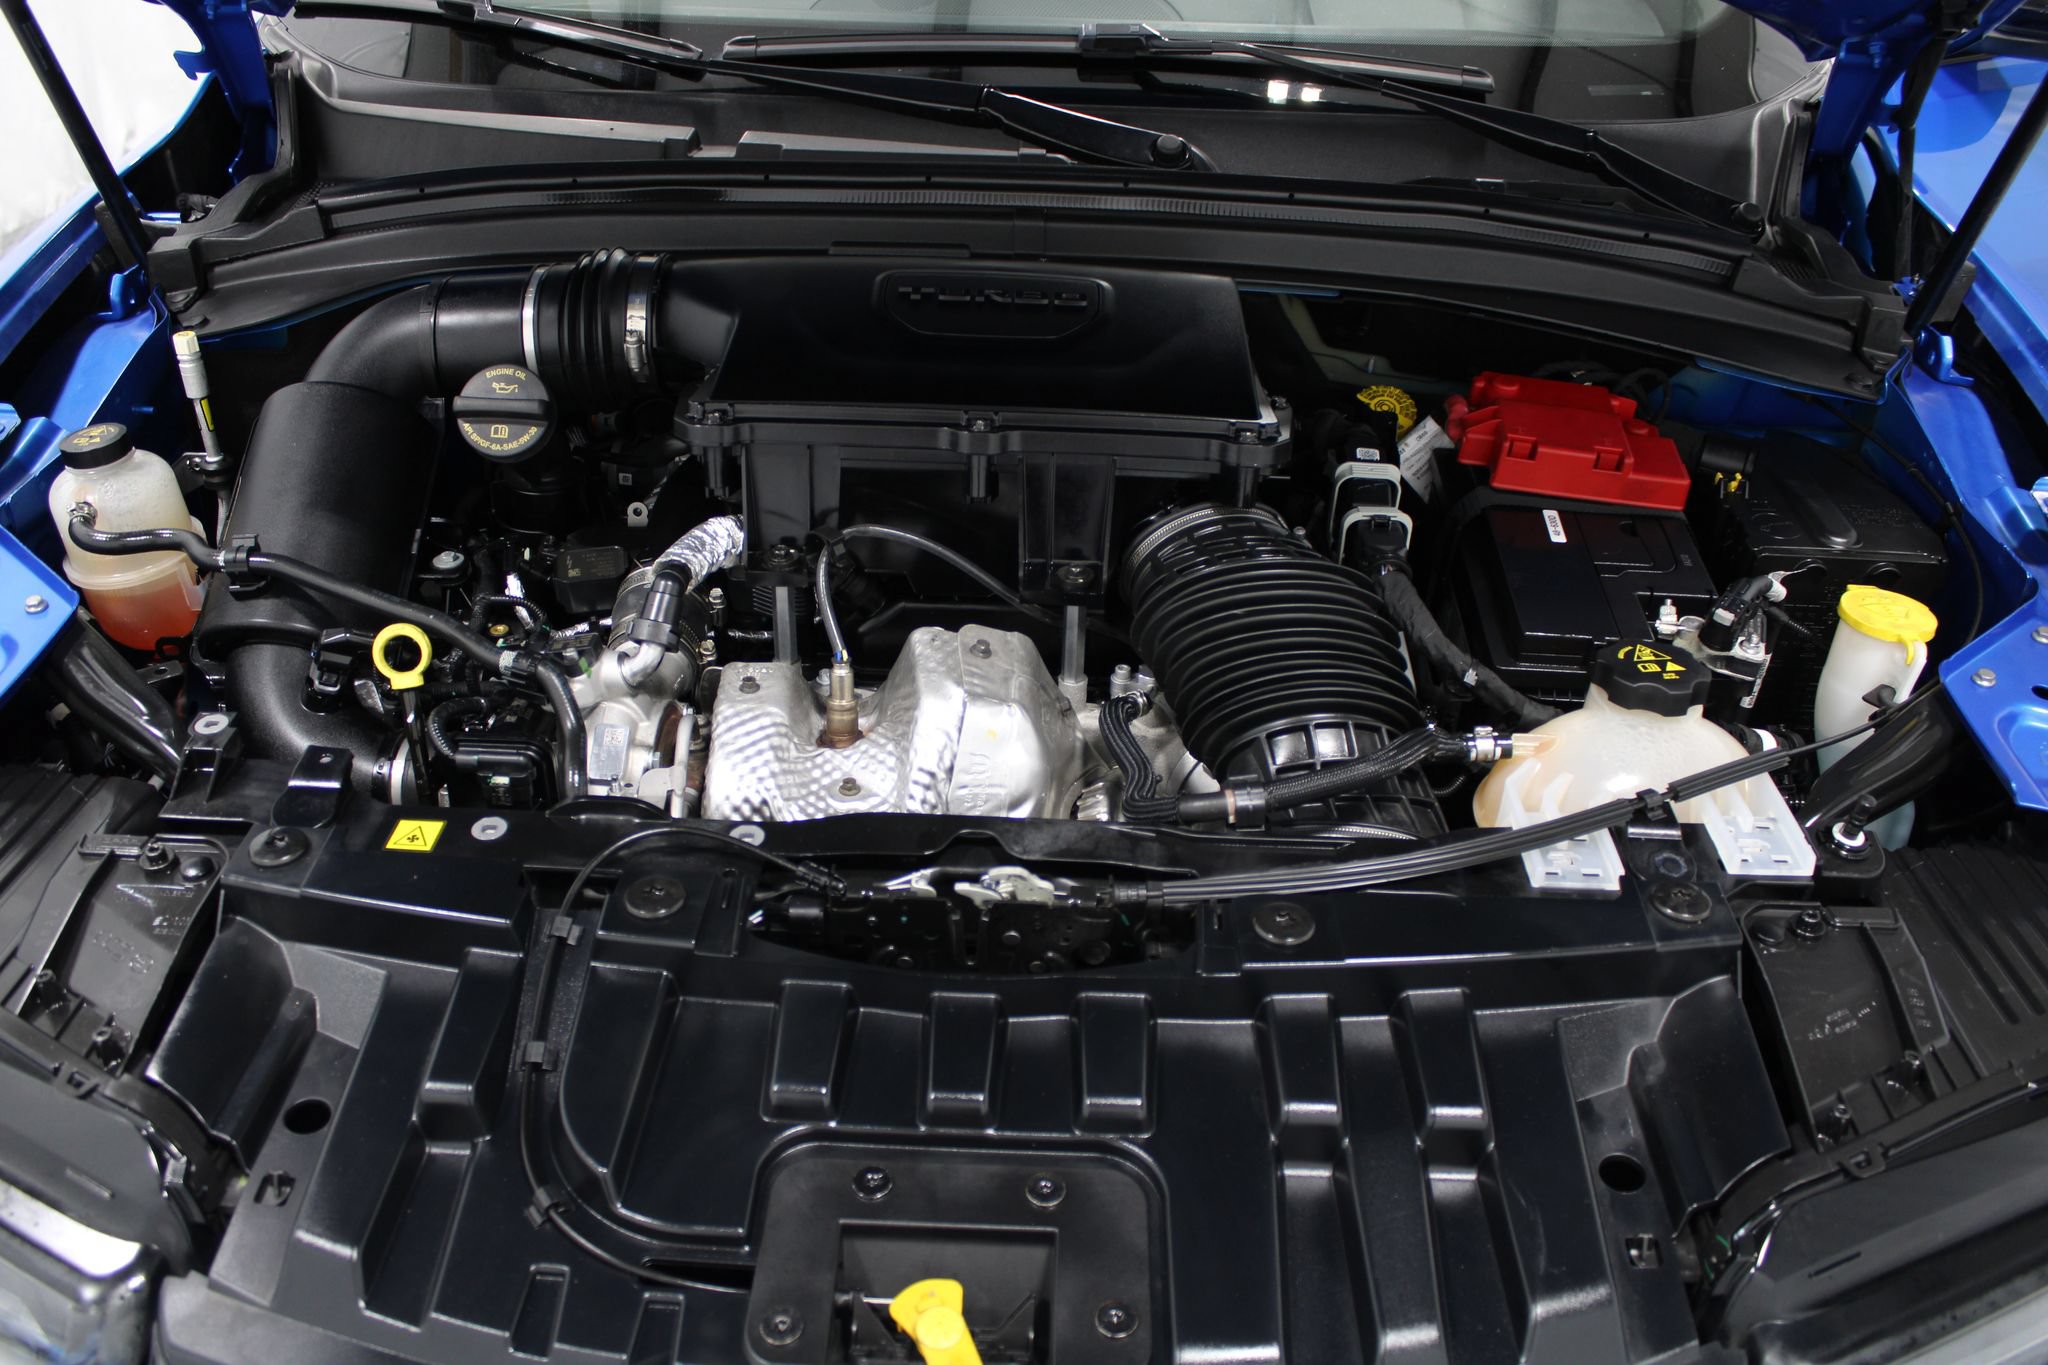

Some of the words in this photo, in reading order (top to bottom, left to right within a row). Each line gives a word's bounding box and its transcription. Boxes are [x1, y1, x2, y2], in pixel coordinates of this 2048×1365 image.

[485, 368, 514, 379] ENGINE
[515, 370, 527, 381] OIL
[463, 423, 472, 435] API
